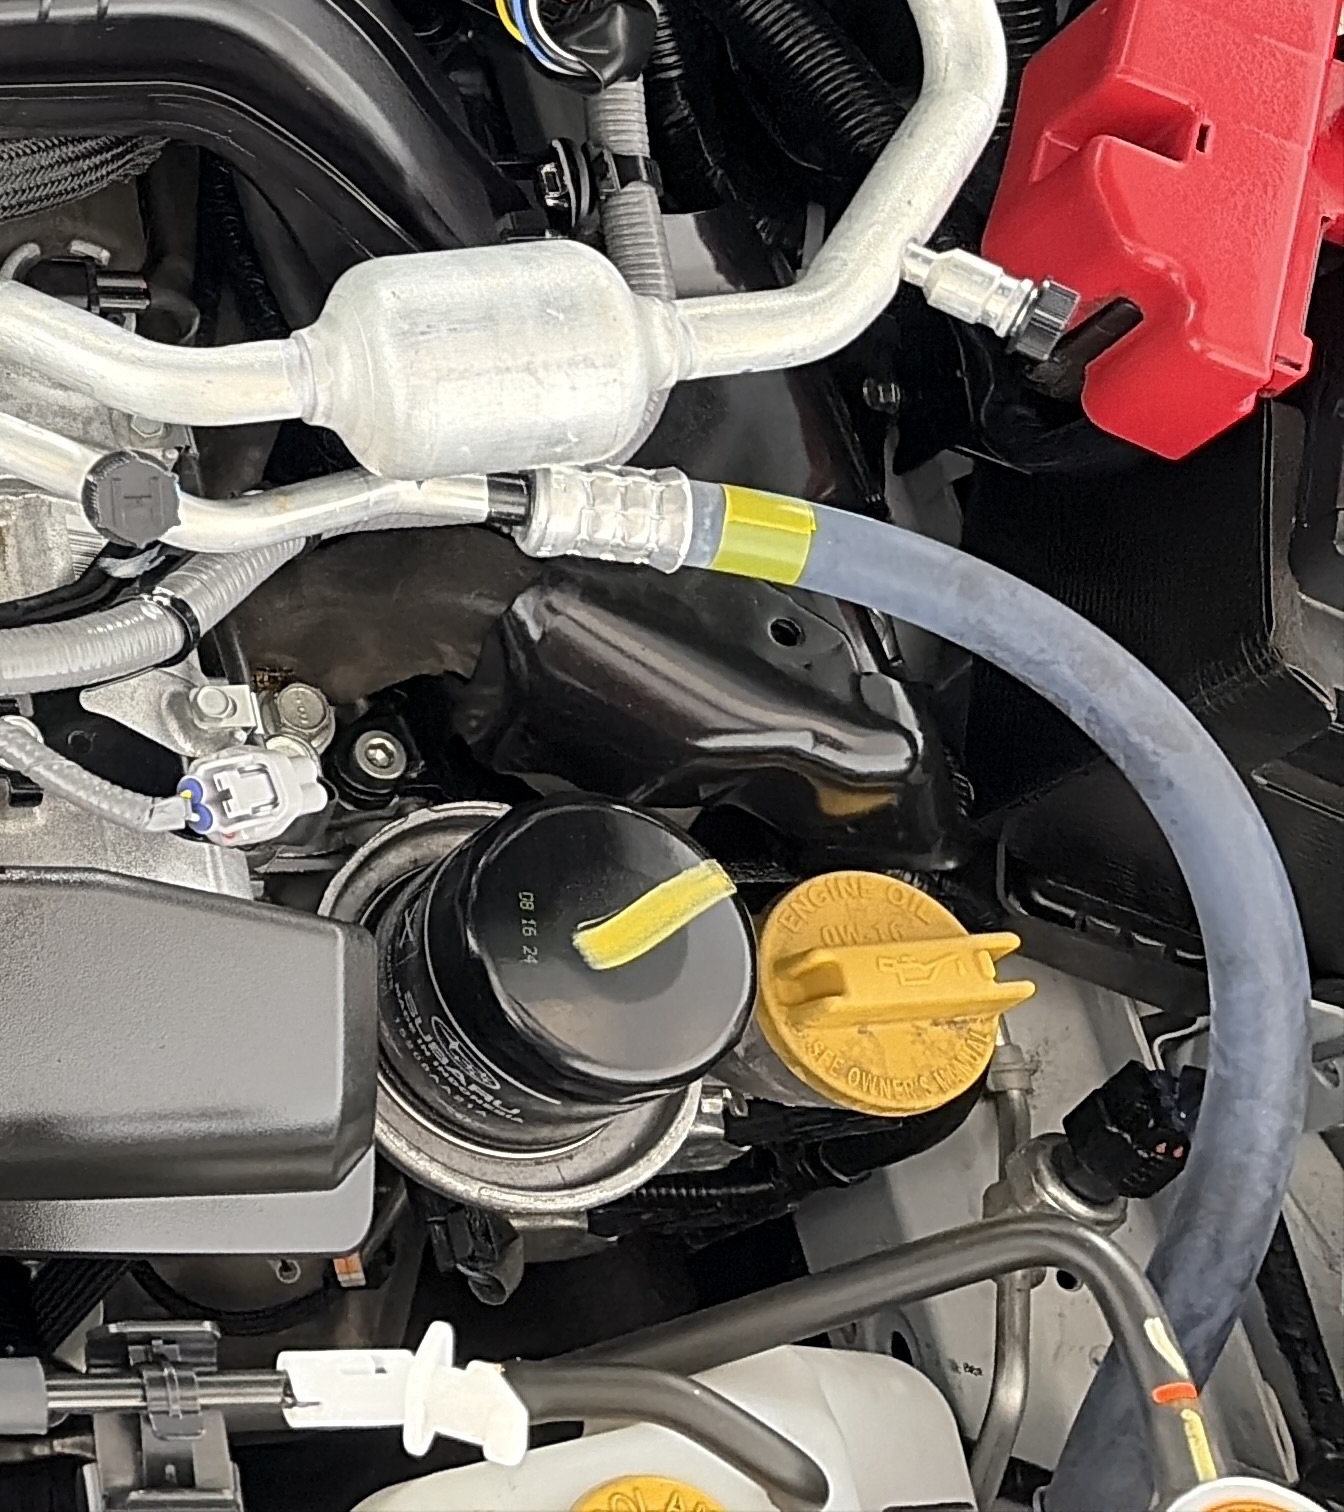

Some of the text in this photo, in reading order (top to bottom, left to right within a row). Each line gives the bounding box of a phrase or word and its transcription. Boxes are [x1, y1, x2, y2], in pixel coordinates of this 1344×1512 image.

[519, 891, 538, 965] 08 16 24
[777, 877, 872, 935] ENGINE
[887, 885, 933, 926] OIL
[820, 920, 903, 946] 0W-16
[395, 983, 417, 1033] MADE
[432, 1059, 524, 1124] INDONESIA
[404, 990, 521, 1116] SUBARU
[808, 1028, 992, 1101] SEE OWNER'S MANUAL
